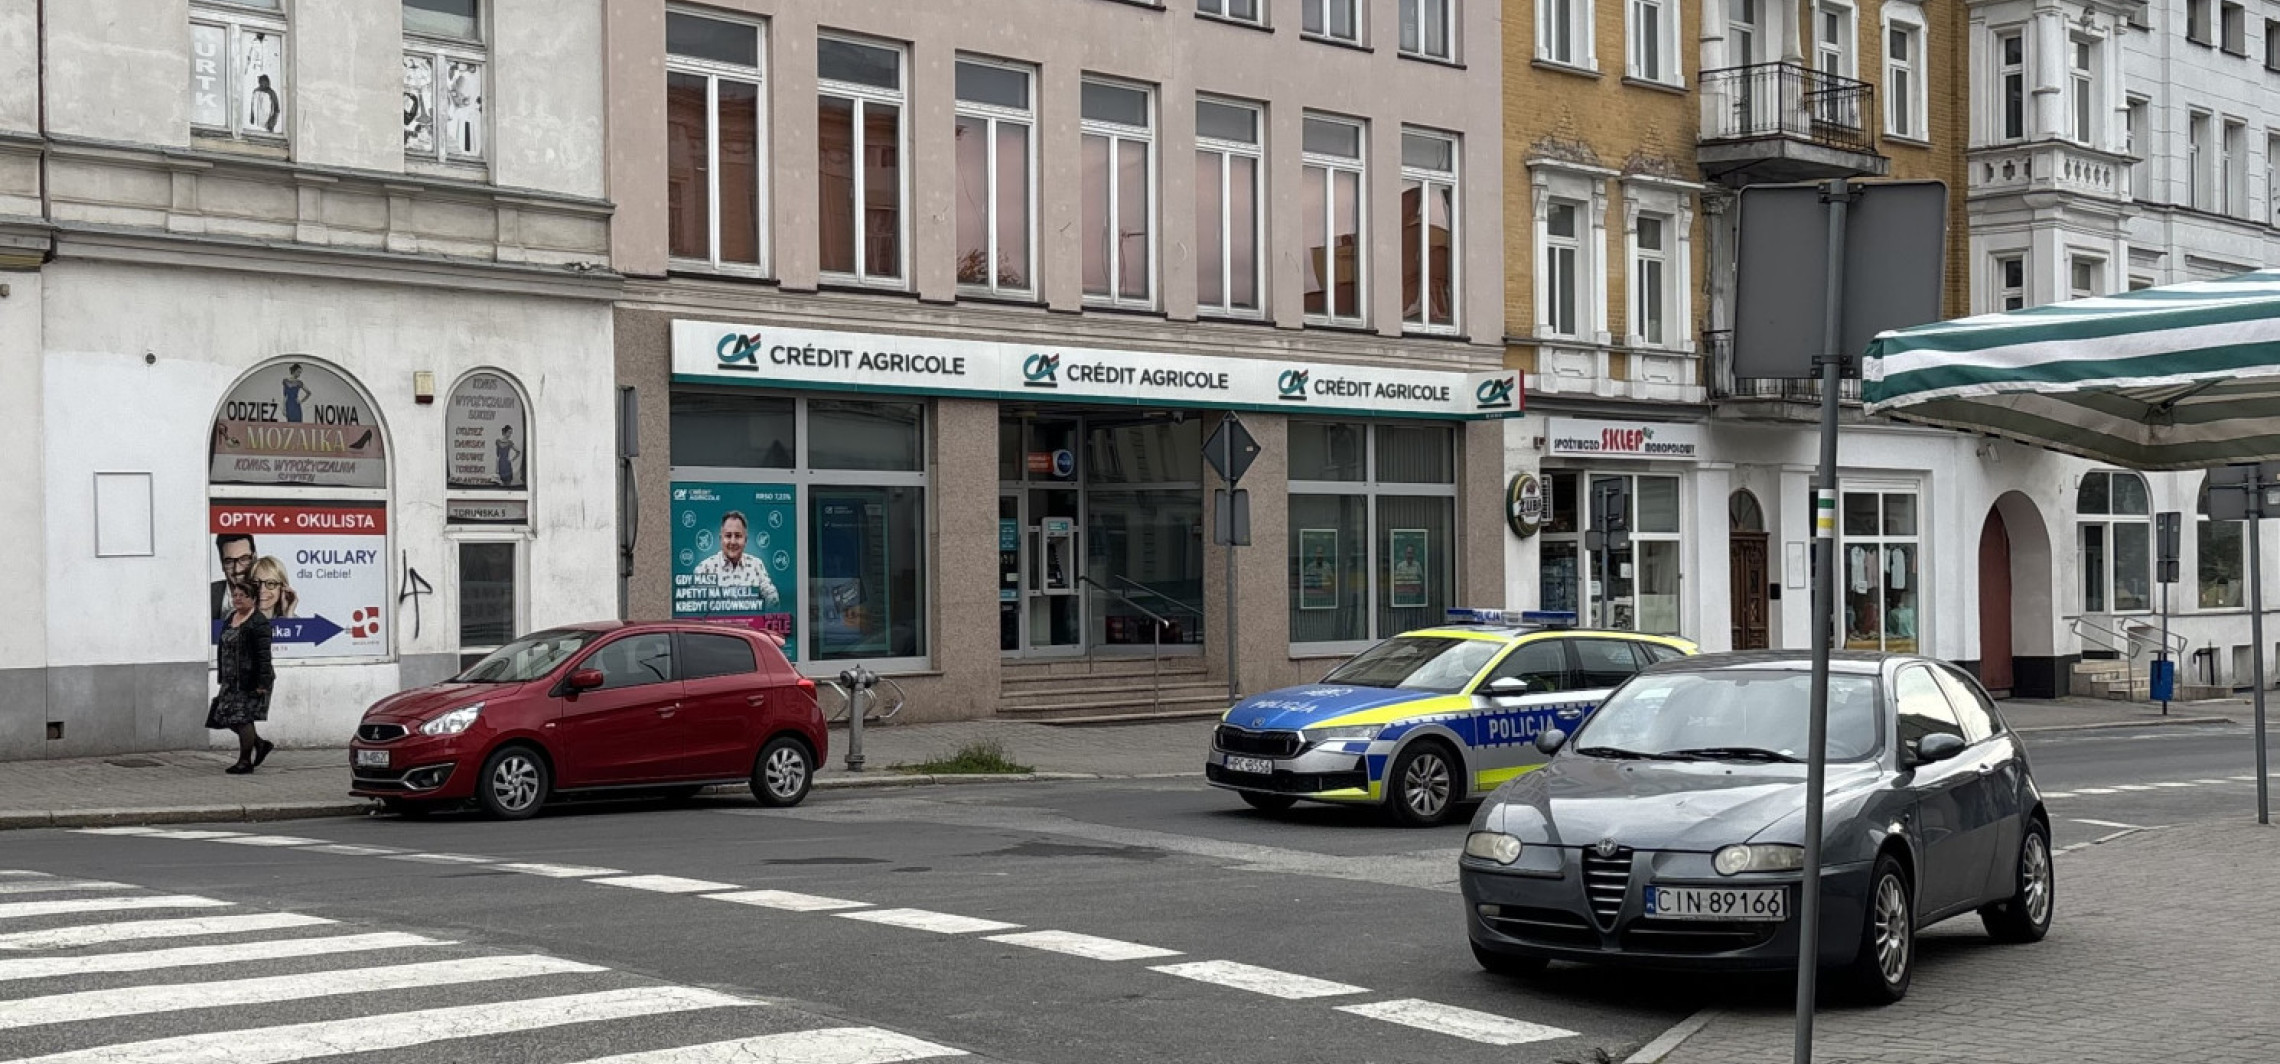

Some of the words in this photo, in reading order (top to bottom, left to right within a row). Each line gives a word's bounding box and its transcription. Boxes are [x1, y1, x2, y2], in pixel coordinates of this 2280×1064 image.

[770, 343, 853, 368] CRÉDIT
[857, 351, 965, 376] AGRICOLE
[1067, 361, 1136, 385] CRÉDIT
[1140, 369, 1229, 390] AGRICOLE
[1314, 377, 1371, 398] CRÉDIT
[1374, 382, 1450, 401] AGRICOLE
[227, 399, 278, 423] ODZIEŻ
[314, 404, 359, 426] NOWA
[246, 426, 346, 452] MOZAIKA
[1601, 427, 1644, 452] SKLEP
[219, 512, 276, 528] OPTYK
[296, 513, 375, 529] OKULISTA
[296, 549, 378, 565] OKULARY
[296, 569, 313, 579] dla
[316, 568, 352, 580] Ciebie!
[675, 574, 693, 585] GDY
[694, 574, 718, 585] MASZ
[675, 587, 707, 599] APETYT
[708, 587, 721, 598] NA
[675, 601, 708, 612] KREDYT
[709, 600, 763, 611] GOTÓWKOWY
[294, 624, 303, 637] 7
[1488, 713, 1556, 740] POLICJA
[1658, 889, 1701, 913] CIN
[1708, 891, 1781, 914] 89166
